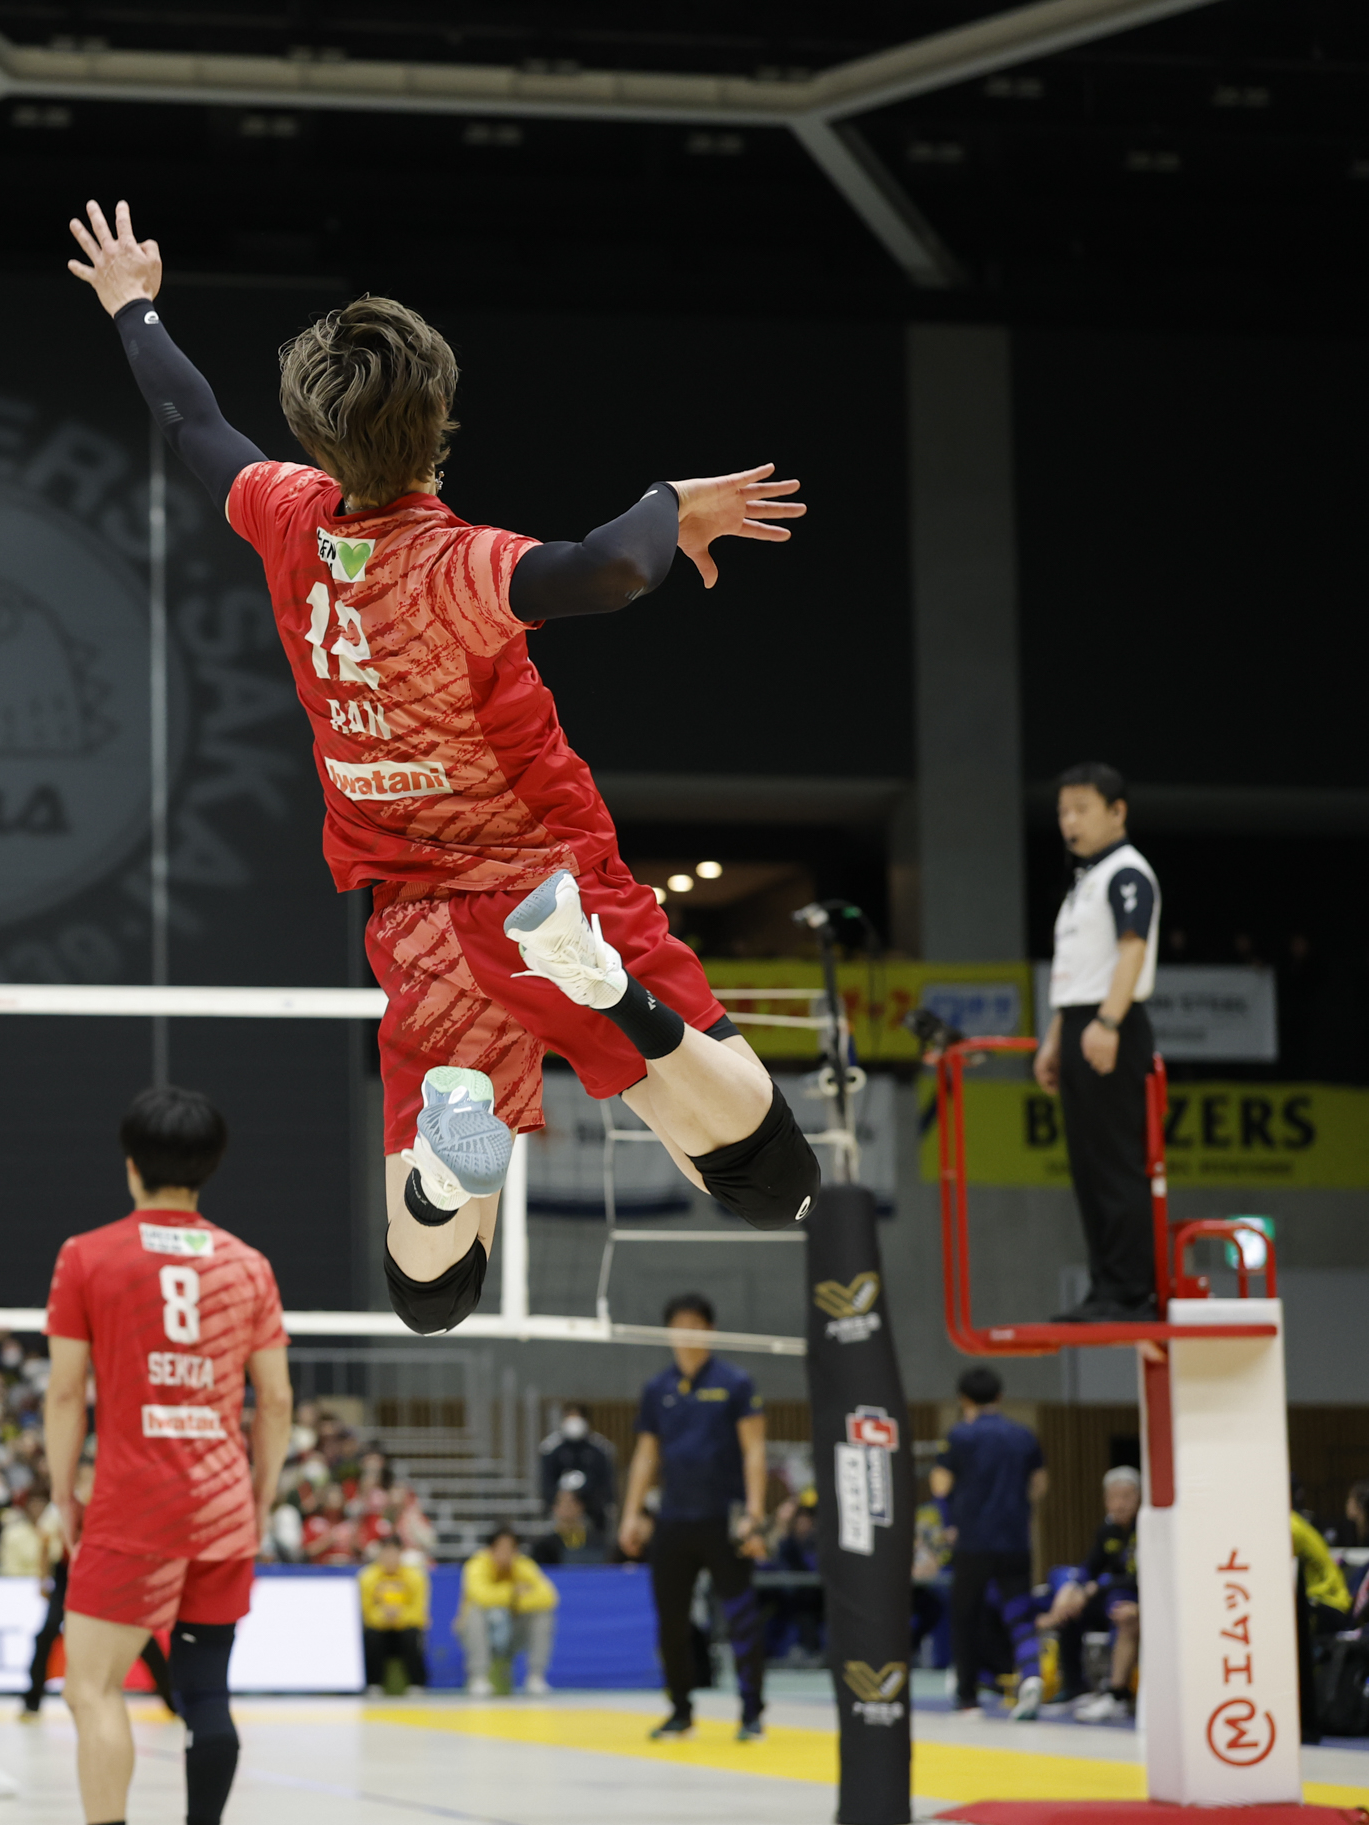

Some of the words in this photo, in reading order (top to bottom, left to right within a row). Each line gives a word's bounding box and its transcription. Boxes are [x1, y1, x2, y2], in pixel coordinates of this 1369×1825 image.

[304, 581, 380, 690] 12
[326, 699, 392, 740] RAN
[1025, 1093, 1317, 1149] BZERS
[159, 1265, 200, 1344] 8
[1216, 1549, 1253, 1685] エムット
